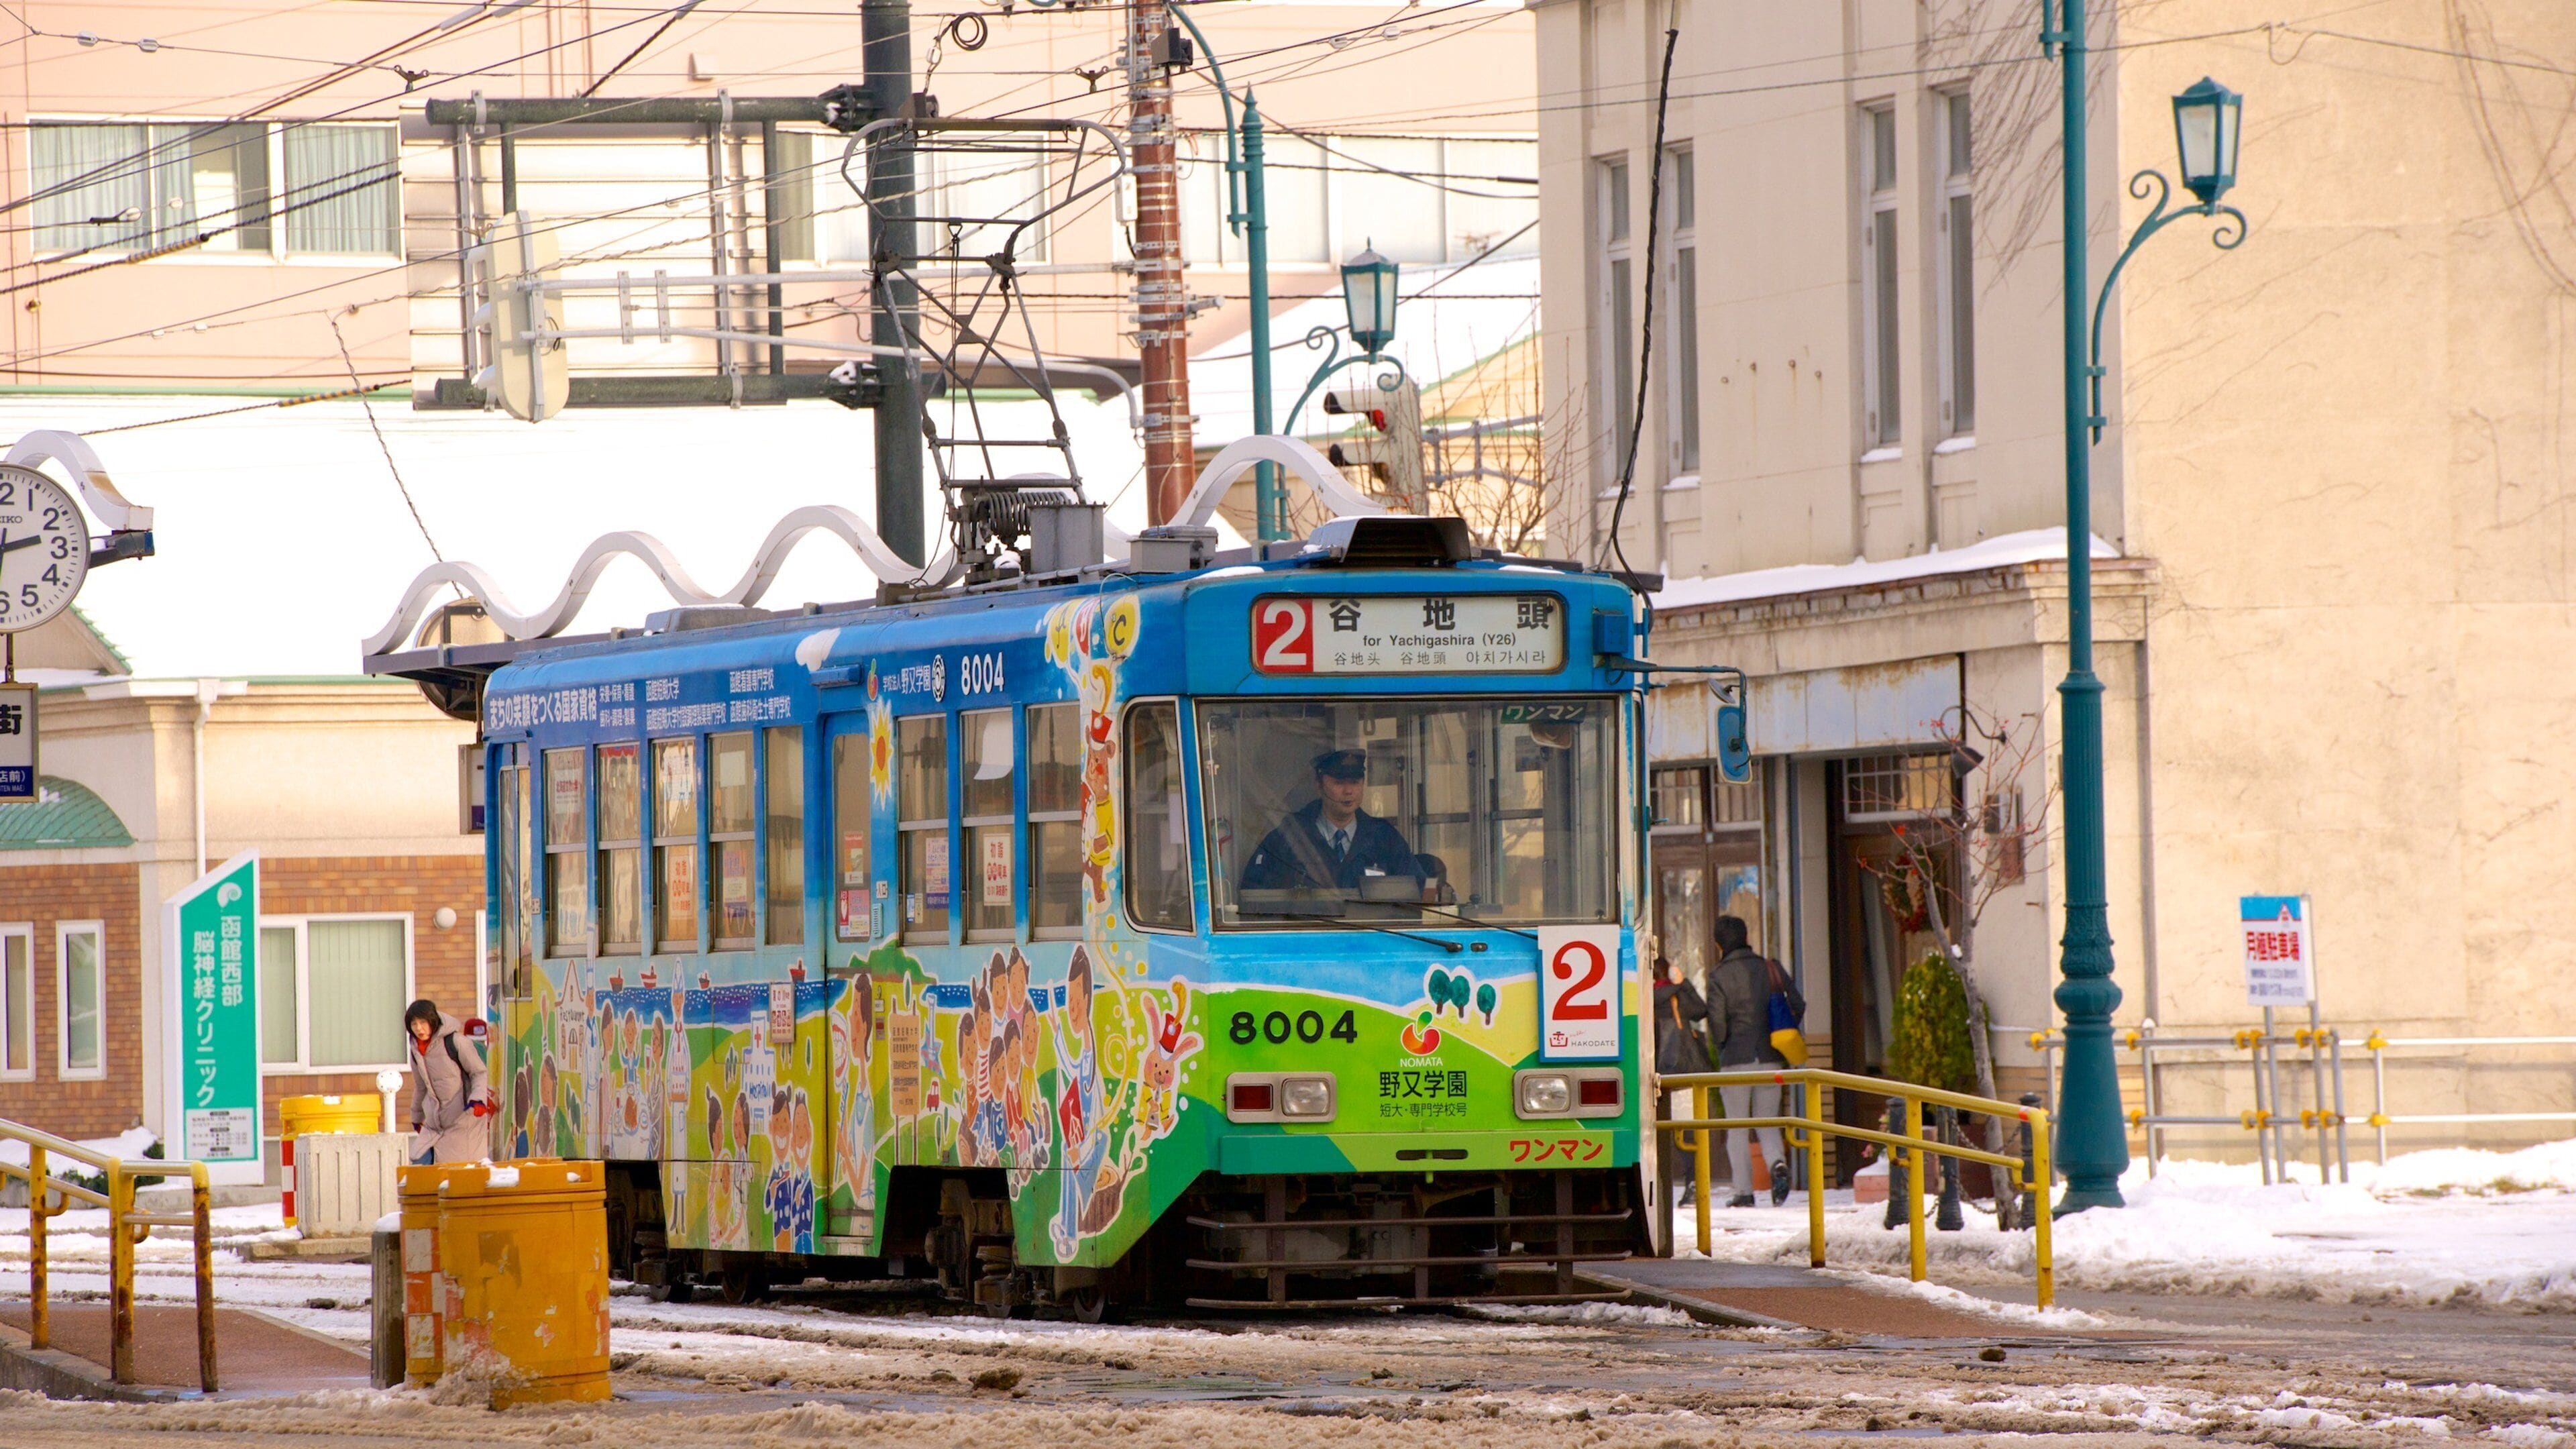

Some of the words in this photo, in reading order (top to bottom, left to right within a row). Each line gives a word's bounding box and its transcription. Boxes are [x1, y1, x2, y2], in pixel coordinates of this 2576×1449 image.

[28, 489, 33, 511] 1
[43, 507, 60, 530] 2
[50, 536, 68, 559] 3
[42, 564, 60, 586] 4
[21, 584, 39, 607] 5
[1329, 598, 1550, 632] 谷地頭
[1113, 614, 1126, 646] C
[1263, 599, 1307, 666] 2
[1363, 635, 1381, 646] for
[1389, 635, 1474, 648] Yachigashira
[1483, 633, 1516, 647] (Y26)
[1334, 652, 1381, 665] 谷地头
[1400, 651, 1446, 665] 谷地頭
[1466, 651, 1546, 665] 야치가시라
[901, 665, 930, 694] 野又学園
[961, 652, 1004, 696] 8004
[490, 687, 597, 729] まちの笑顔をつくる国家資格
[1504, 704, 1584, 720] ワンマン
[221, 916, 243, 1007] 函館西部
[1552, 941, 1607, 1020] 2
[193, 930, 216, 1107] 脳神経クリニック
[1229, 1010, 1357, 1044] 8004
[1400, 1057, 1443, 1067] NOMATA
[1379, 1070, 1467, 1098] 野又学園
[1379, 1102, 1467, 1118] 短大・専門学校号
[1509, 1140, 1603, 1163] ワンマン
